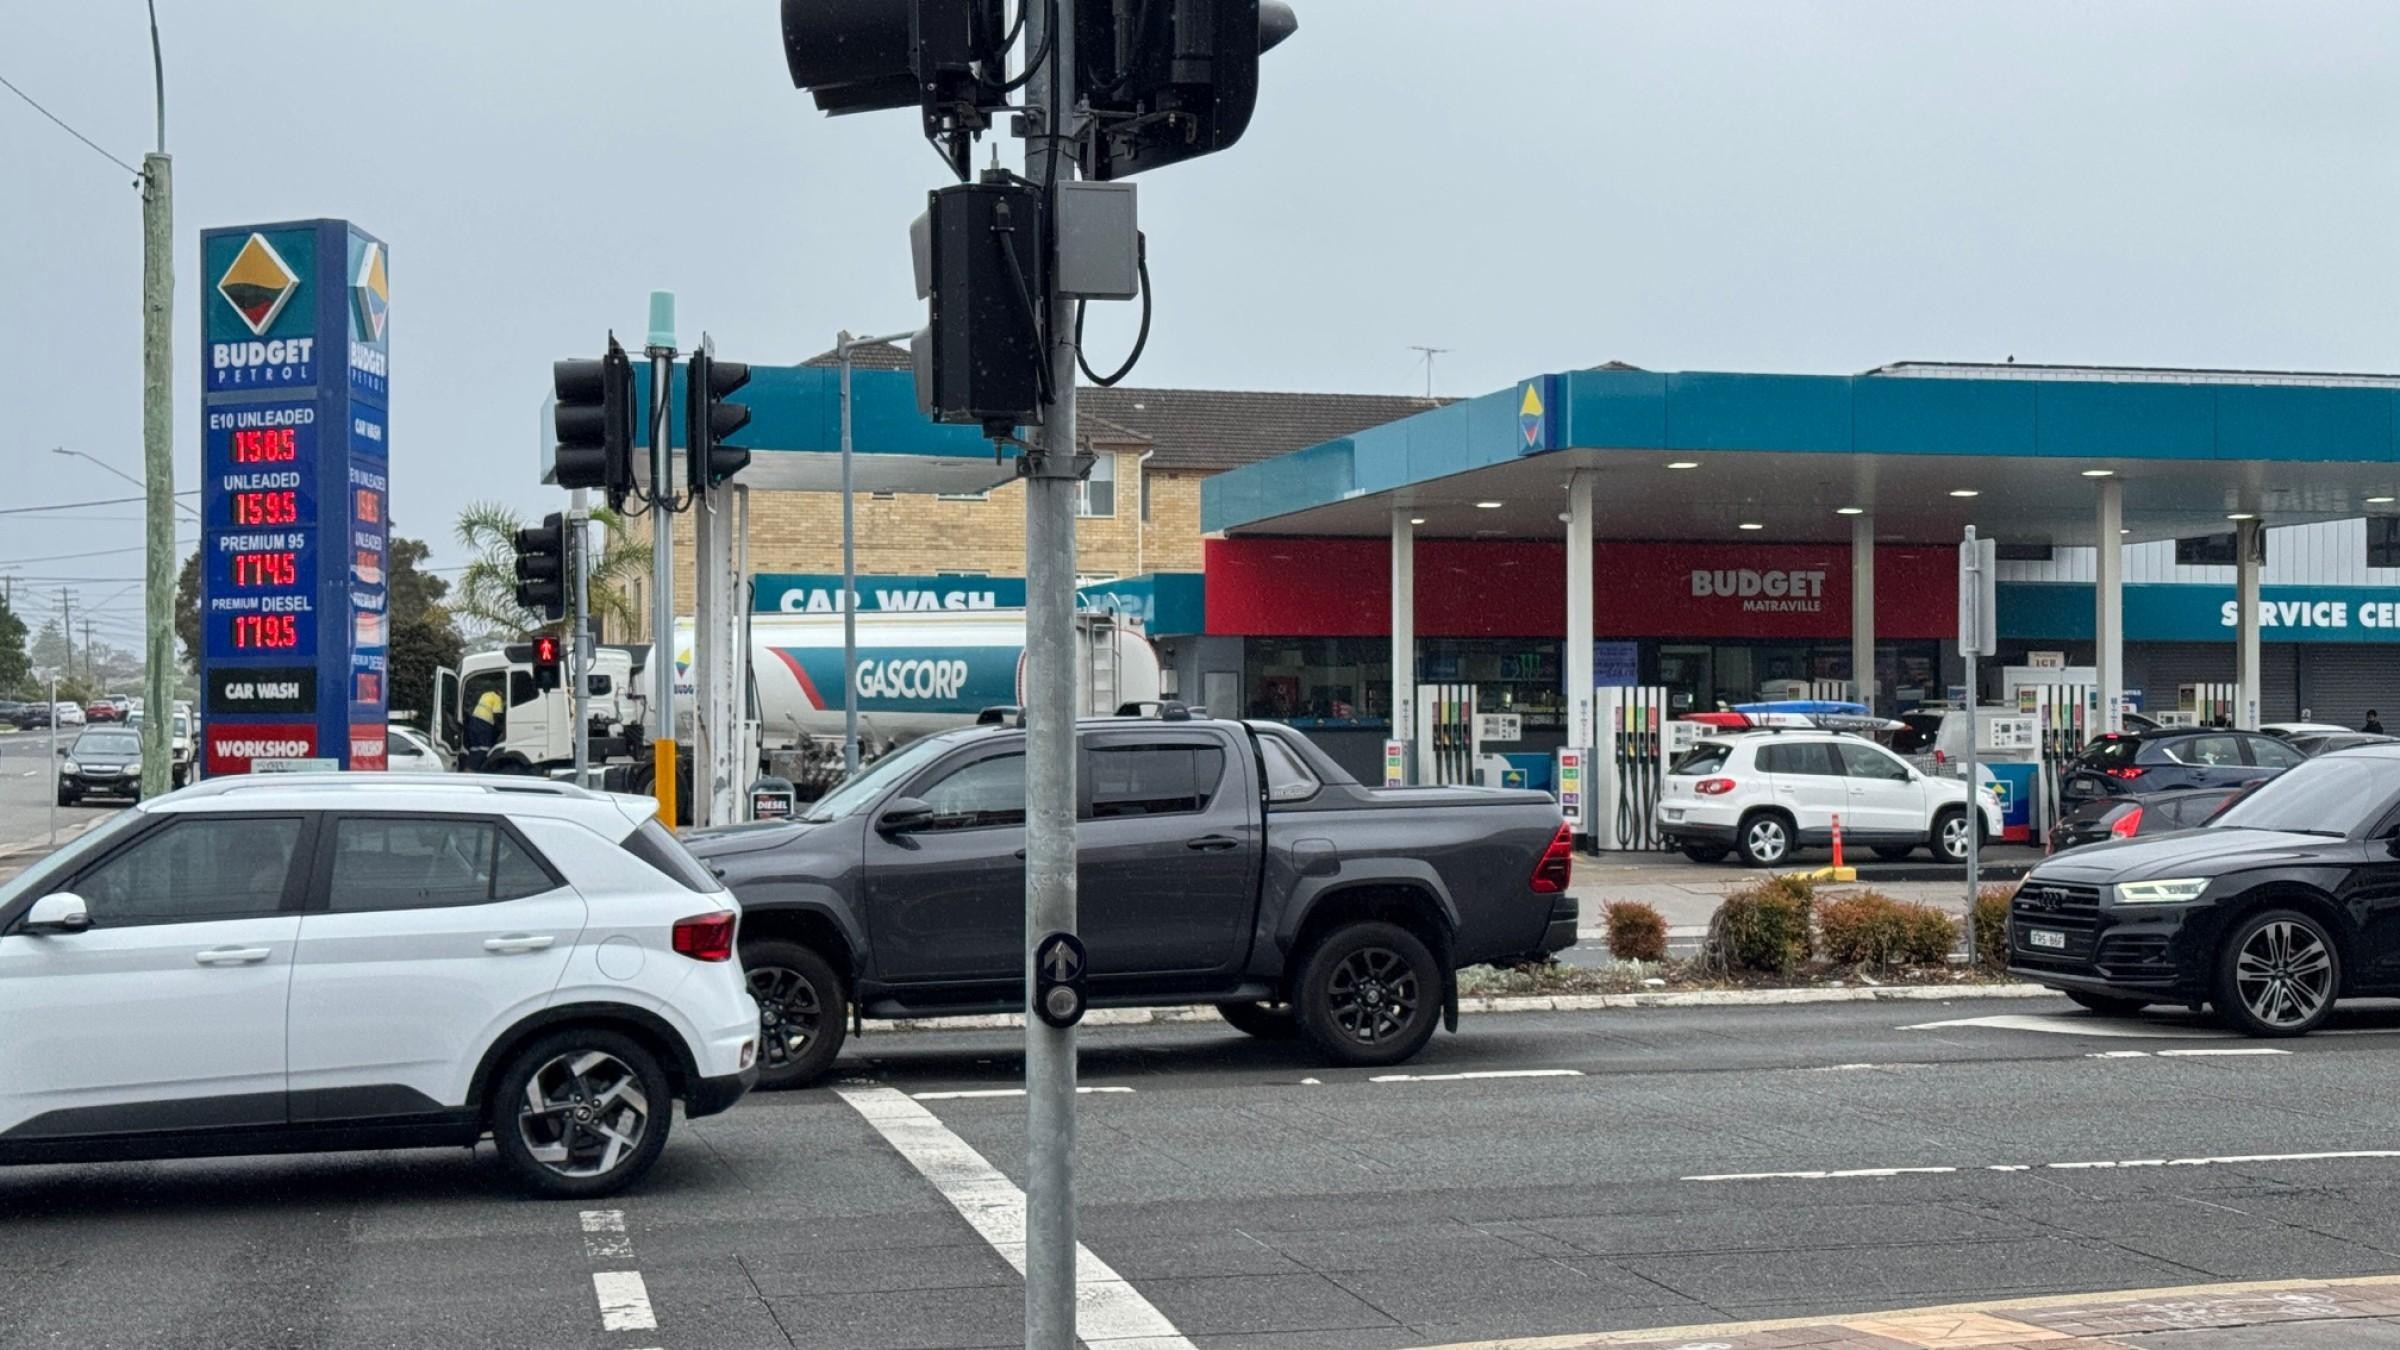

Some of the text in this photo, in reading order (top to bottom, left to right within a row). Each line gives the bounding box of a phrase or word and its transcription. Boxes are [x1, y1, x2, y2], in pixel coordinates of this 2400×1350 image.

[213, 338, 313, 368] BUDGET
[218, 365, 307, 384] PETROL
[210, 408, 314, 429] E10 UNLEADED
[223, 472, 300, 490] UNLEADED
[237, 491, 297, 524] 159.5
[220, 533, 305, 551] PREMIUM 95
[235, 552, 295, 586] 174.5
[1691, 569, 1825, 597] BUDGET
[212, 596, 312, 612] PREMIUM DIESEL
[1743, 600, 1821, 612] MATRAVILLE
[2221, 601, 2400, 628] SRVICE CE
[235, 615, 297, 648] 179.5
[855, 659, 968, 699] GASCORP
[225, 682, 299, 699] CAR WASH
[215, 740, 309, 757] WORKSHOP
[756, 801, 788, 809] DIESEL
